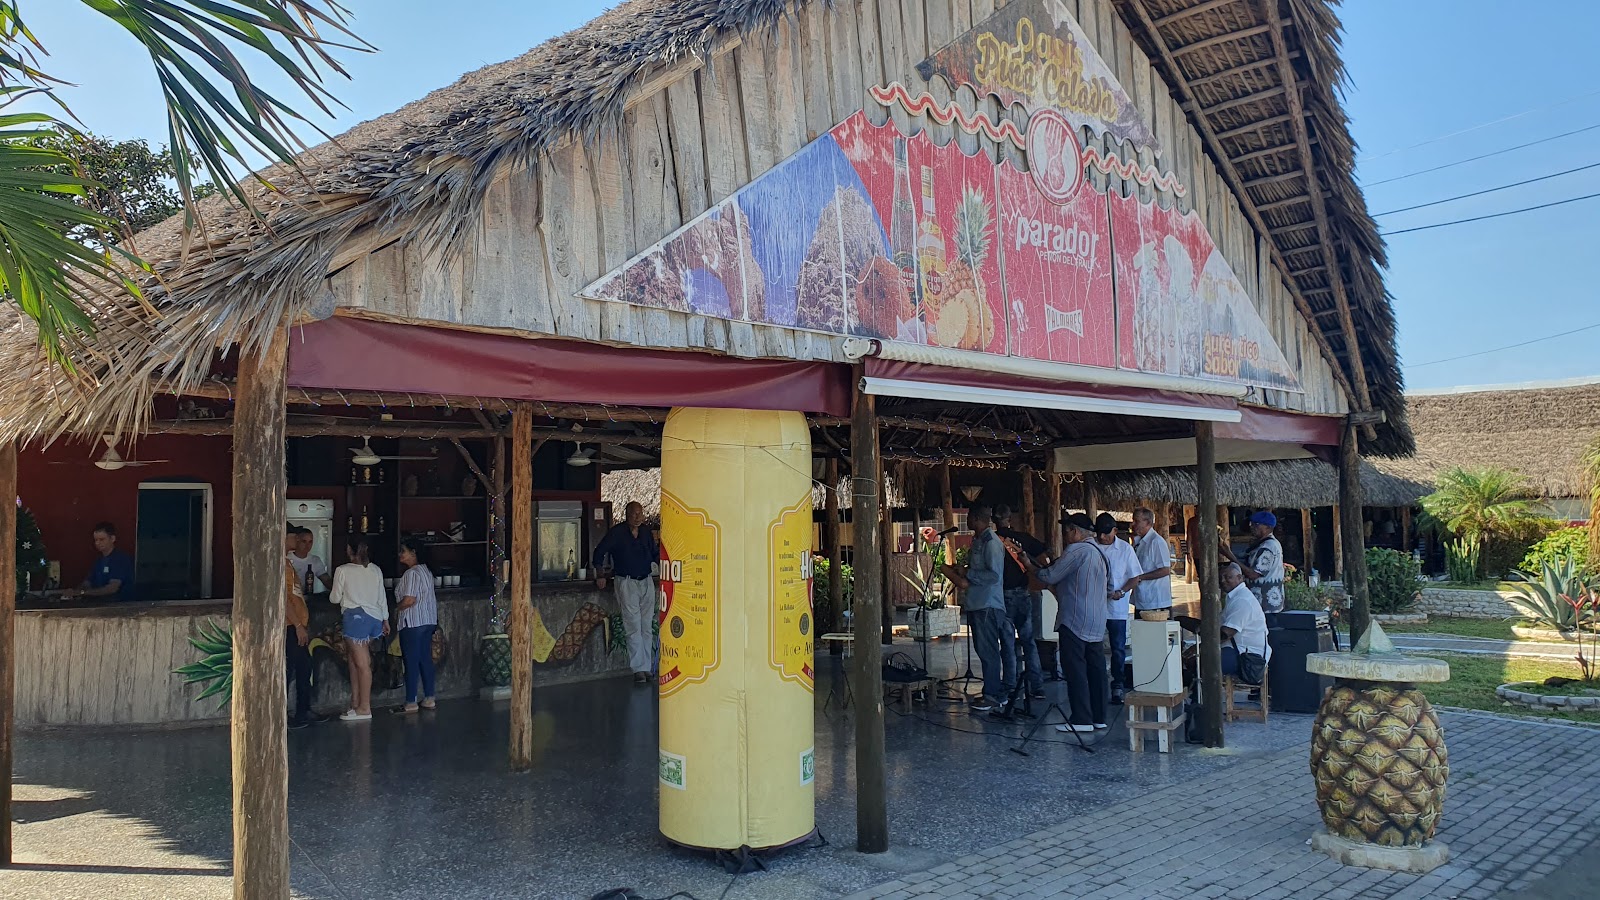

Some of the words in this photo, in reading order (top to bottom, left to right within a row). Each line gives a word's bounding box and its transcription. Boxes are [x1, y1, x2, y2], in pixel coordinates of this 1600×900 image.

[1015, 17, 1083, 72] Oasis
[1041, 58, 1118, 123] Colada
[1016, 216, 1099, 259] parador
[1046, 307, 1083, 334] PALMARES
